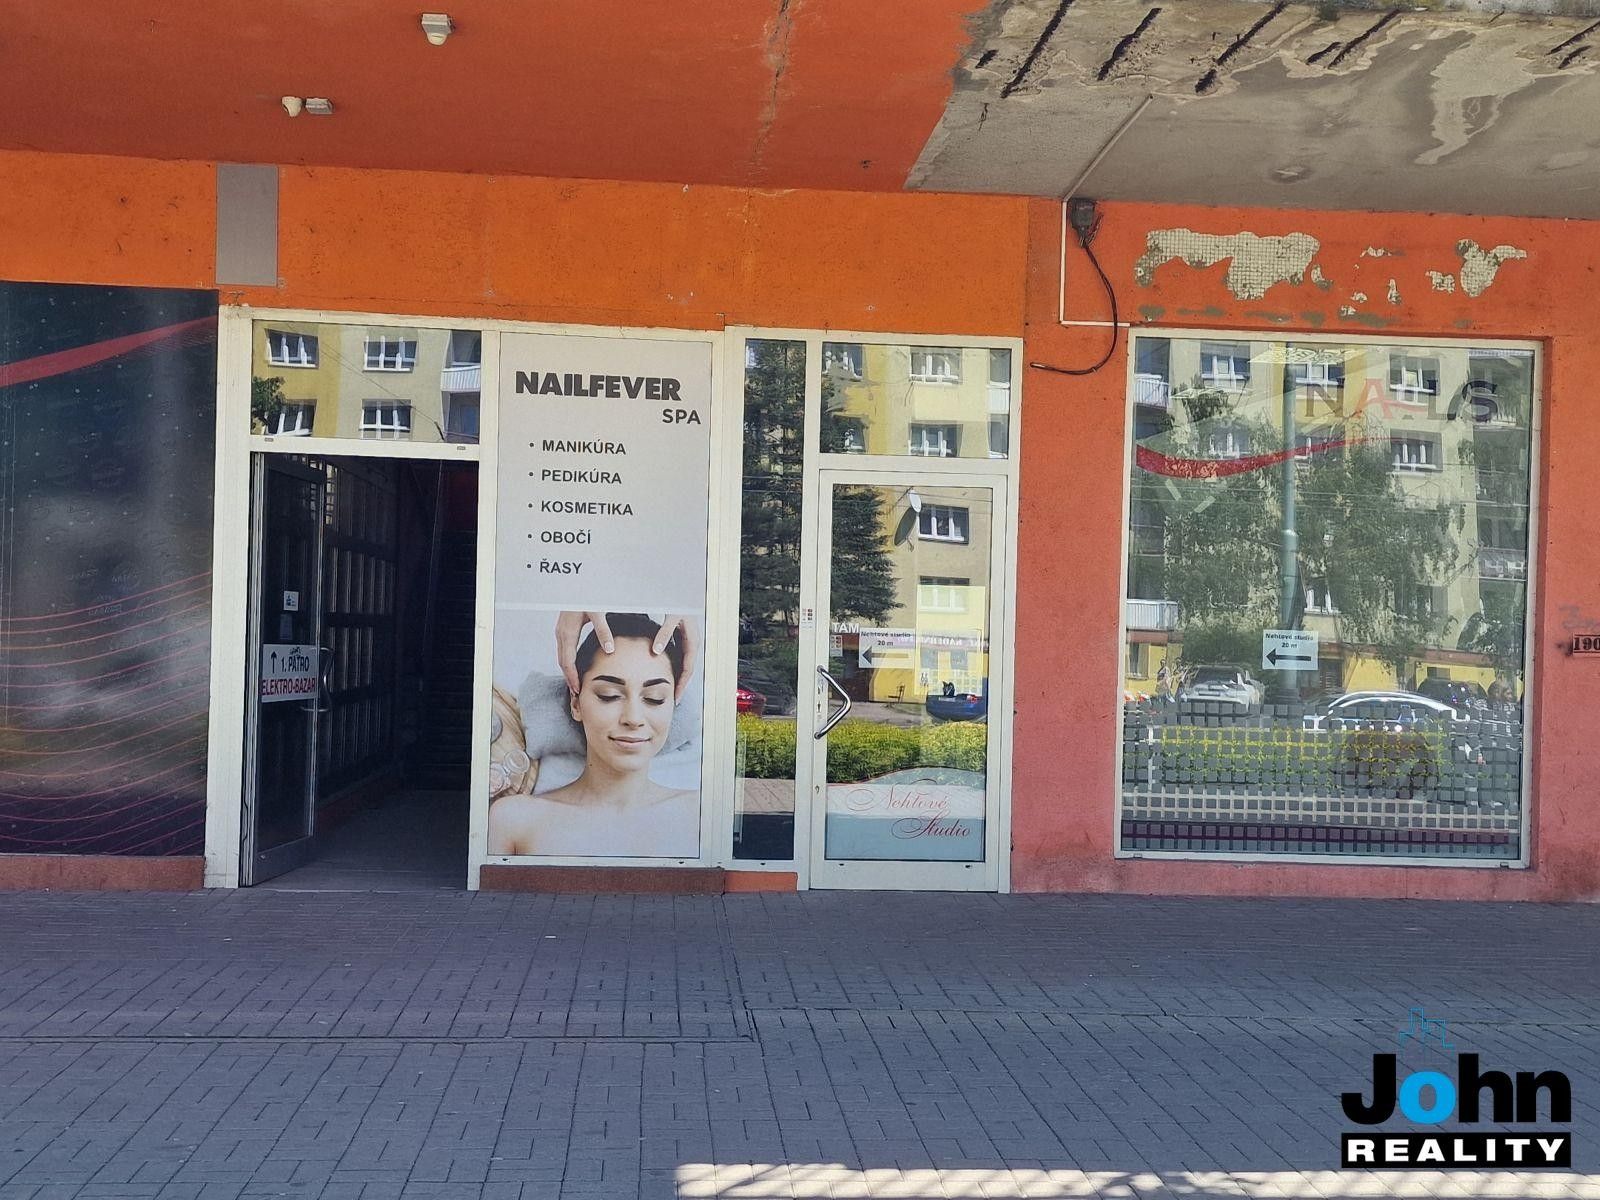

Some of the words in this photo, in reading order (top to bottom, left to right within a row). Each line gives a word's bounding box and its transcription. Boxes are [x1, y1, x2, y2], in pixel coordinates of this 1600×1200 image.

[515, 371, 682, 401] NAILFEVER
[662, 408, 701, 425] SPA
[542, 439, 626, 455] MANIKÚRA
[541, 468, 622, 484] PEDIKÚRA
[541, 500, 633, 516] KOSMETIKA
[540, 530, 591, 544] OBOČÍ
[539, 558, 583, 574] ŘASY
[261, 677, 316, 696] ELEKTRO-BAZAR
